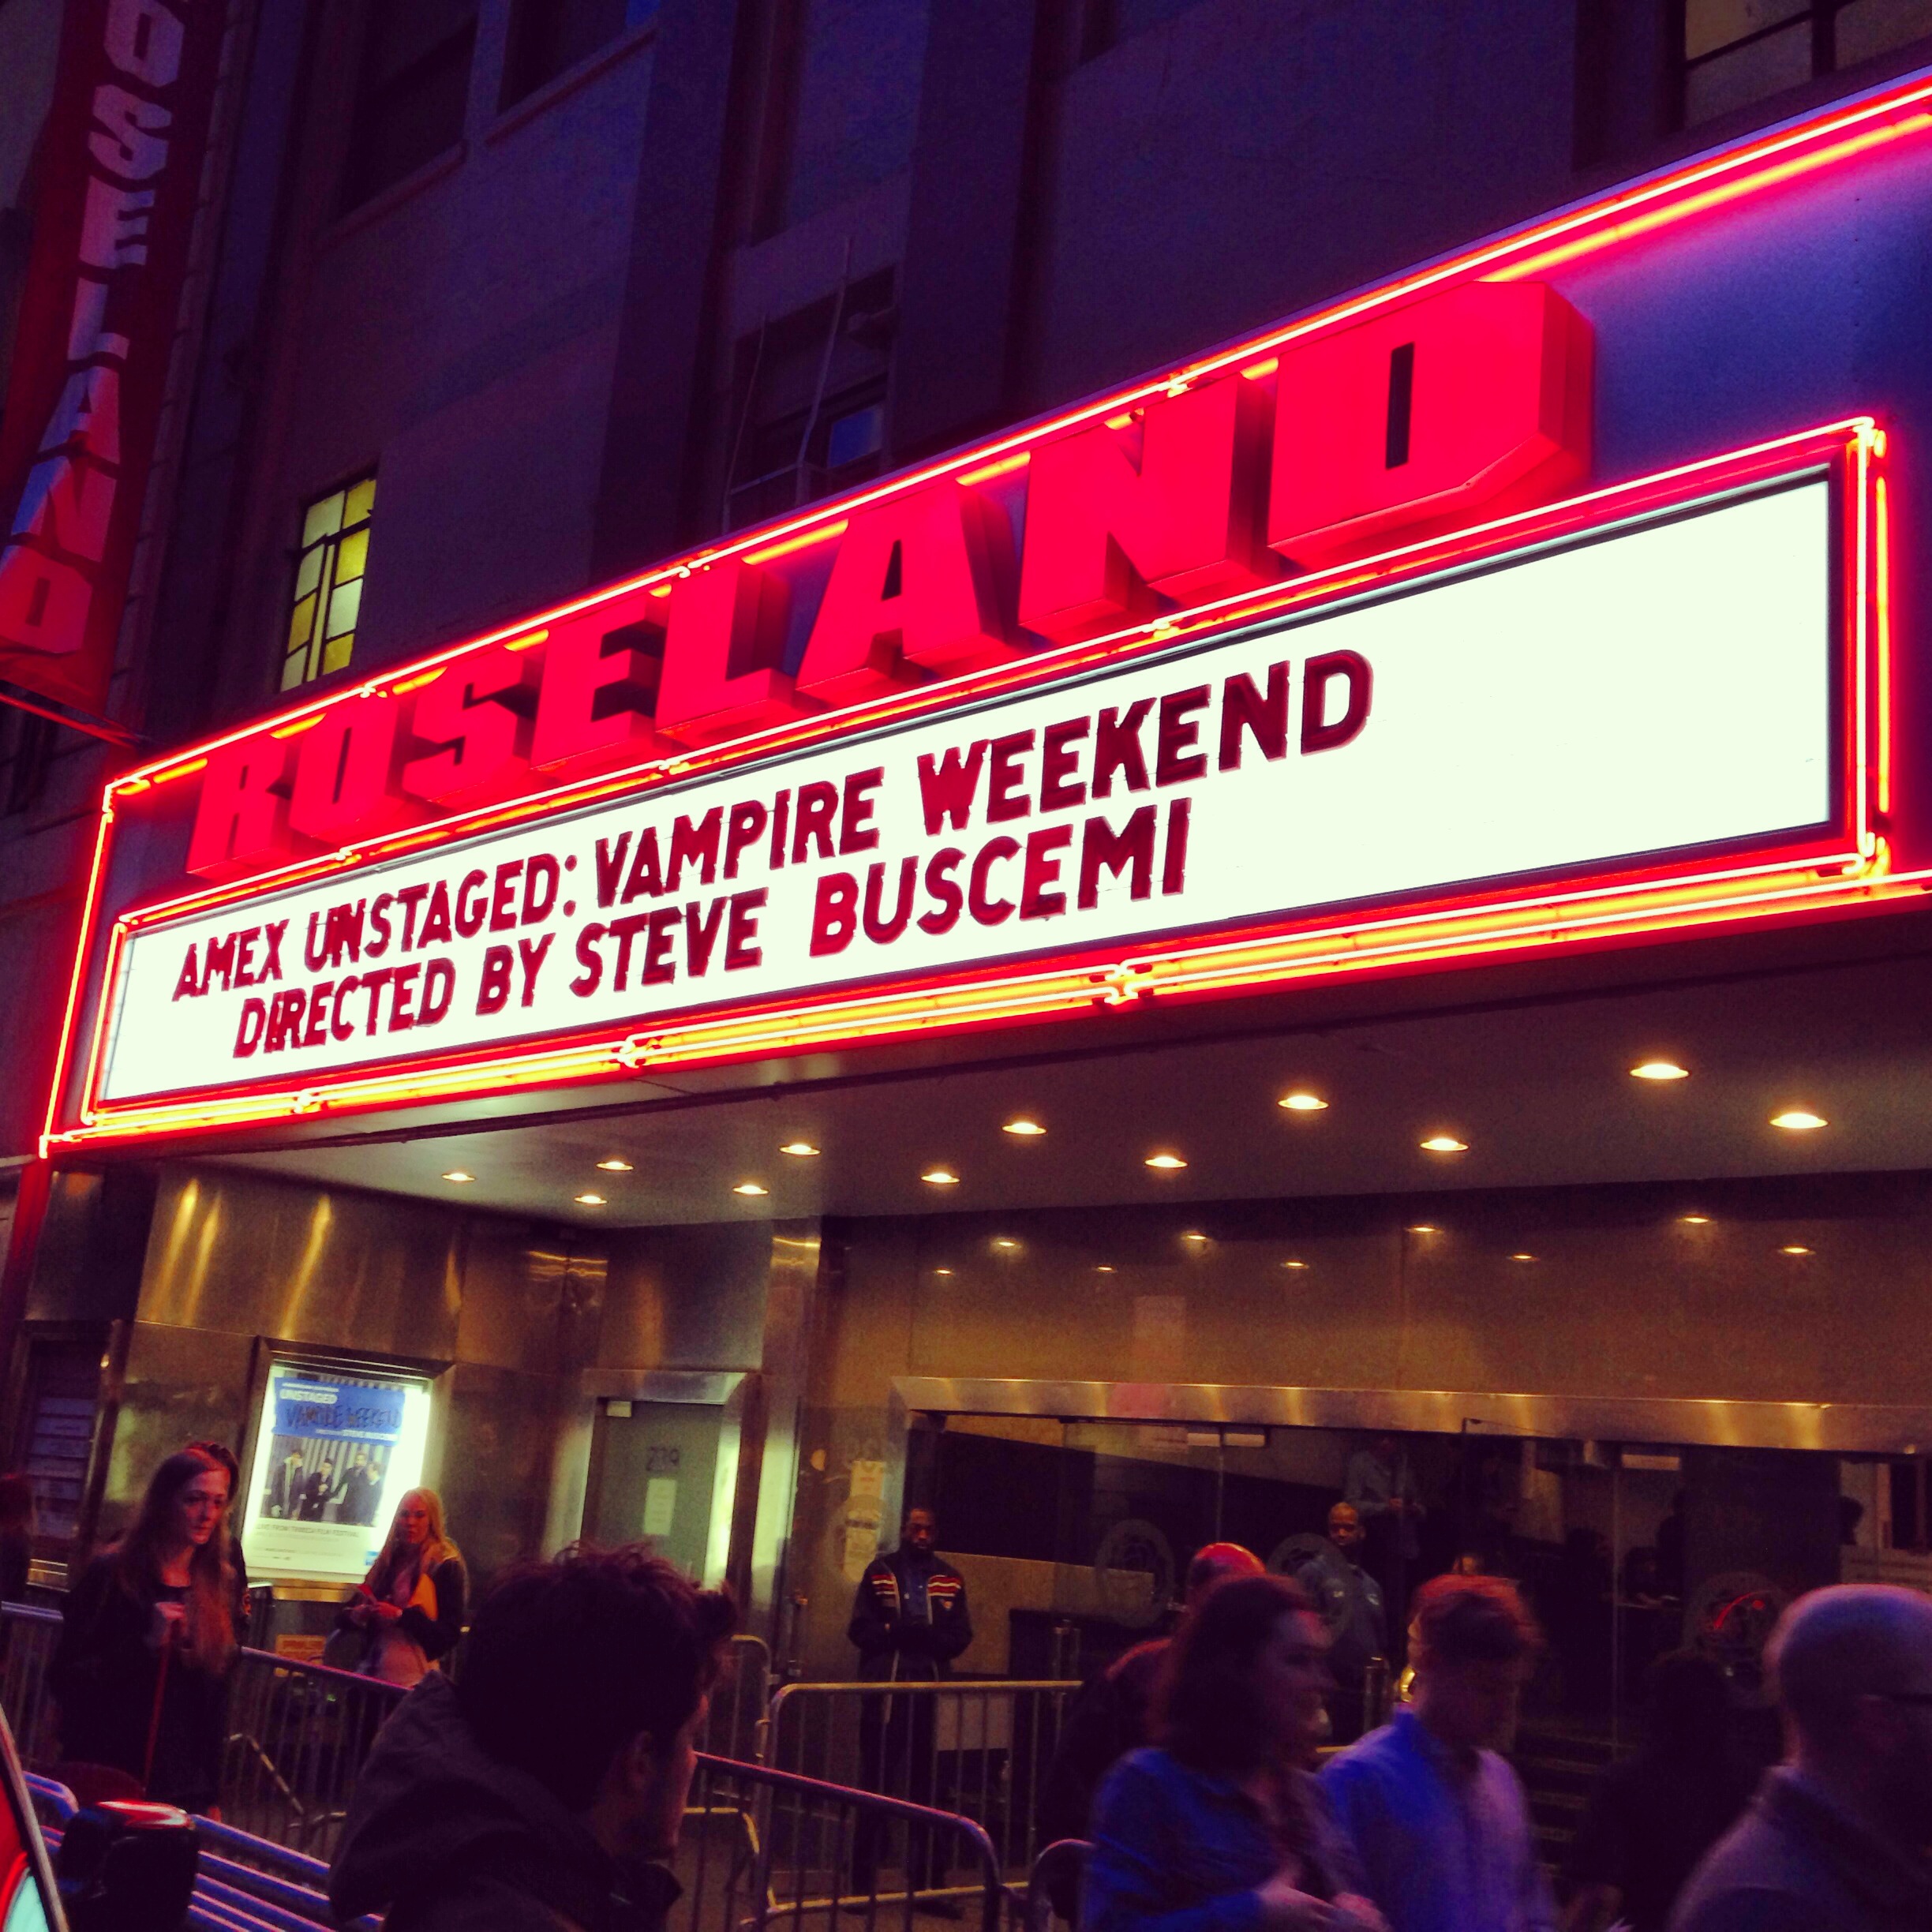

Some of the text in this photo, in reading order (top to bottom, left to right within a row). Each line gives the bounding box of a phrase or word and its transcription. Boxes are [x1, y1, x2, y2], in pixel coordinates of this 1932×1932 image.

[186, 280, 1593, 878] ROSELAND
[172, 649, 1373, 1002] AMEX UNSTAGED: VAMPIRE WEEKEND
[233, 797, 1192, 1058] DIRECTED BY STEVE BUSCEMI
